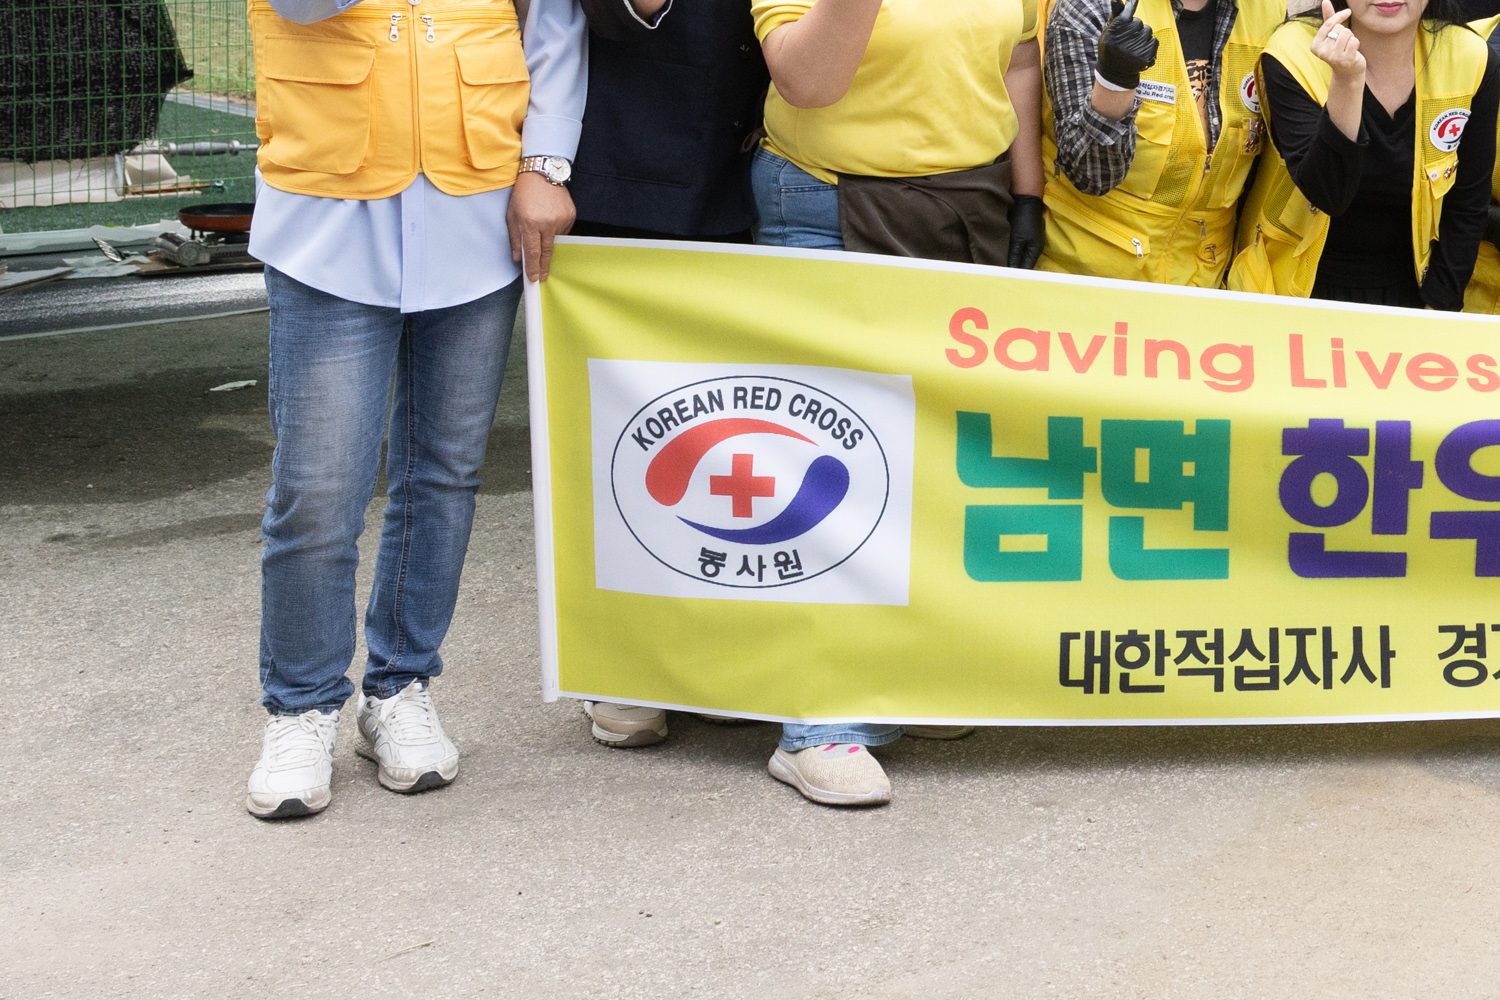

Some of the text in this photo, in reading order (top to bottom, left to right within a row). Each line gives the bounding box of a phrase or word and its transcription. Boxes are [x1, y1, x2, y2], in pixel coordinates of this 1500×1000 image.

[945, 306, 1255, 393] Saving
[630, 385, 865, 452] KOREAN RED CROSS
[955, 410, 1231, 583] 남면
[698, 546, 804, 582] 봉사원
[1059, 624, 1396, 695] 대한적십자사
